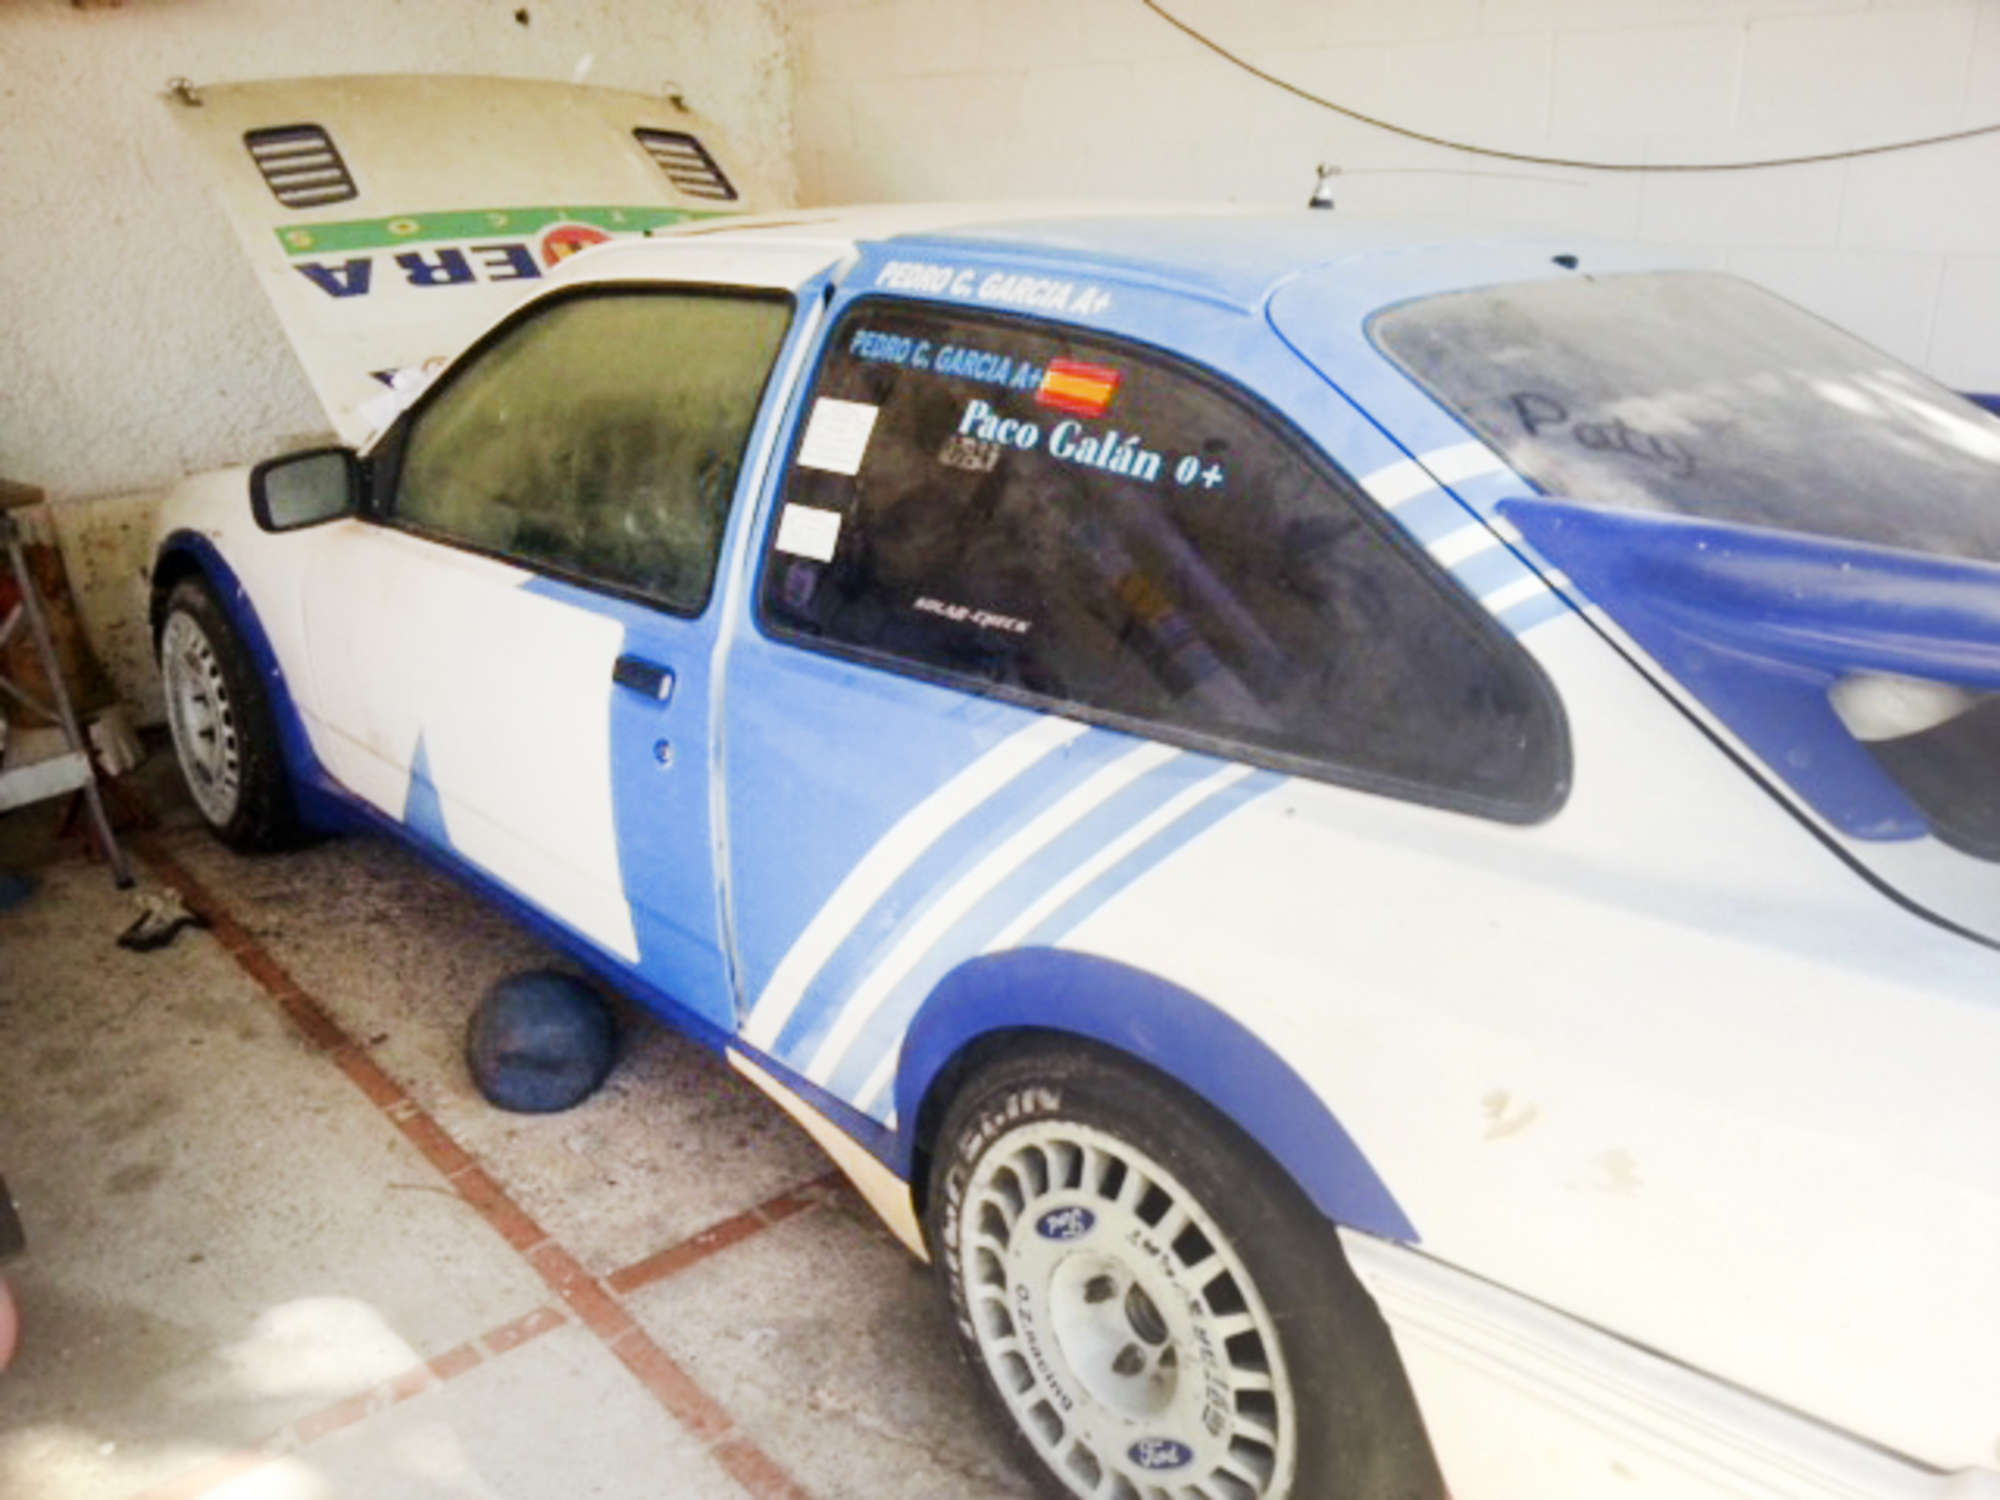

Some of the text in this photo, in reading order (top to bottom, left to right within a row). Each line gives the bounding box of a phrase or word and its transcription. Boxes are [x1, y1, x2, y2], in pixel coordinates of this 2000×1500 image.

[875, 261, 955, 292] PEDRO
[978, 273, 1075, 311] GARCIA
[1068, 286, 1113, 315] A+
[850, 329, 912, 364] PEDRO
[934, 346, 1011, 384] GARCIA
[958, 399, 1040, 450] Paco
[1049, 418, 1163, 483] Galán
